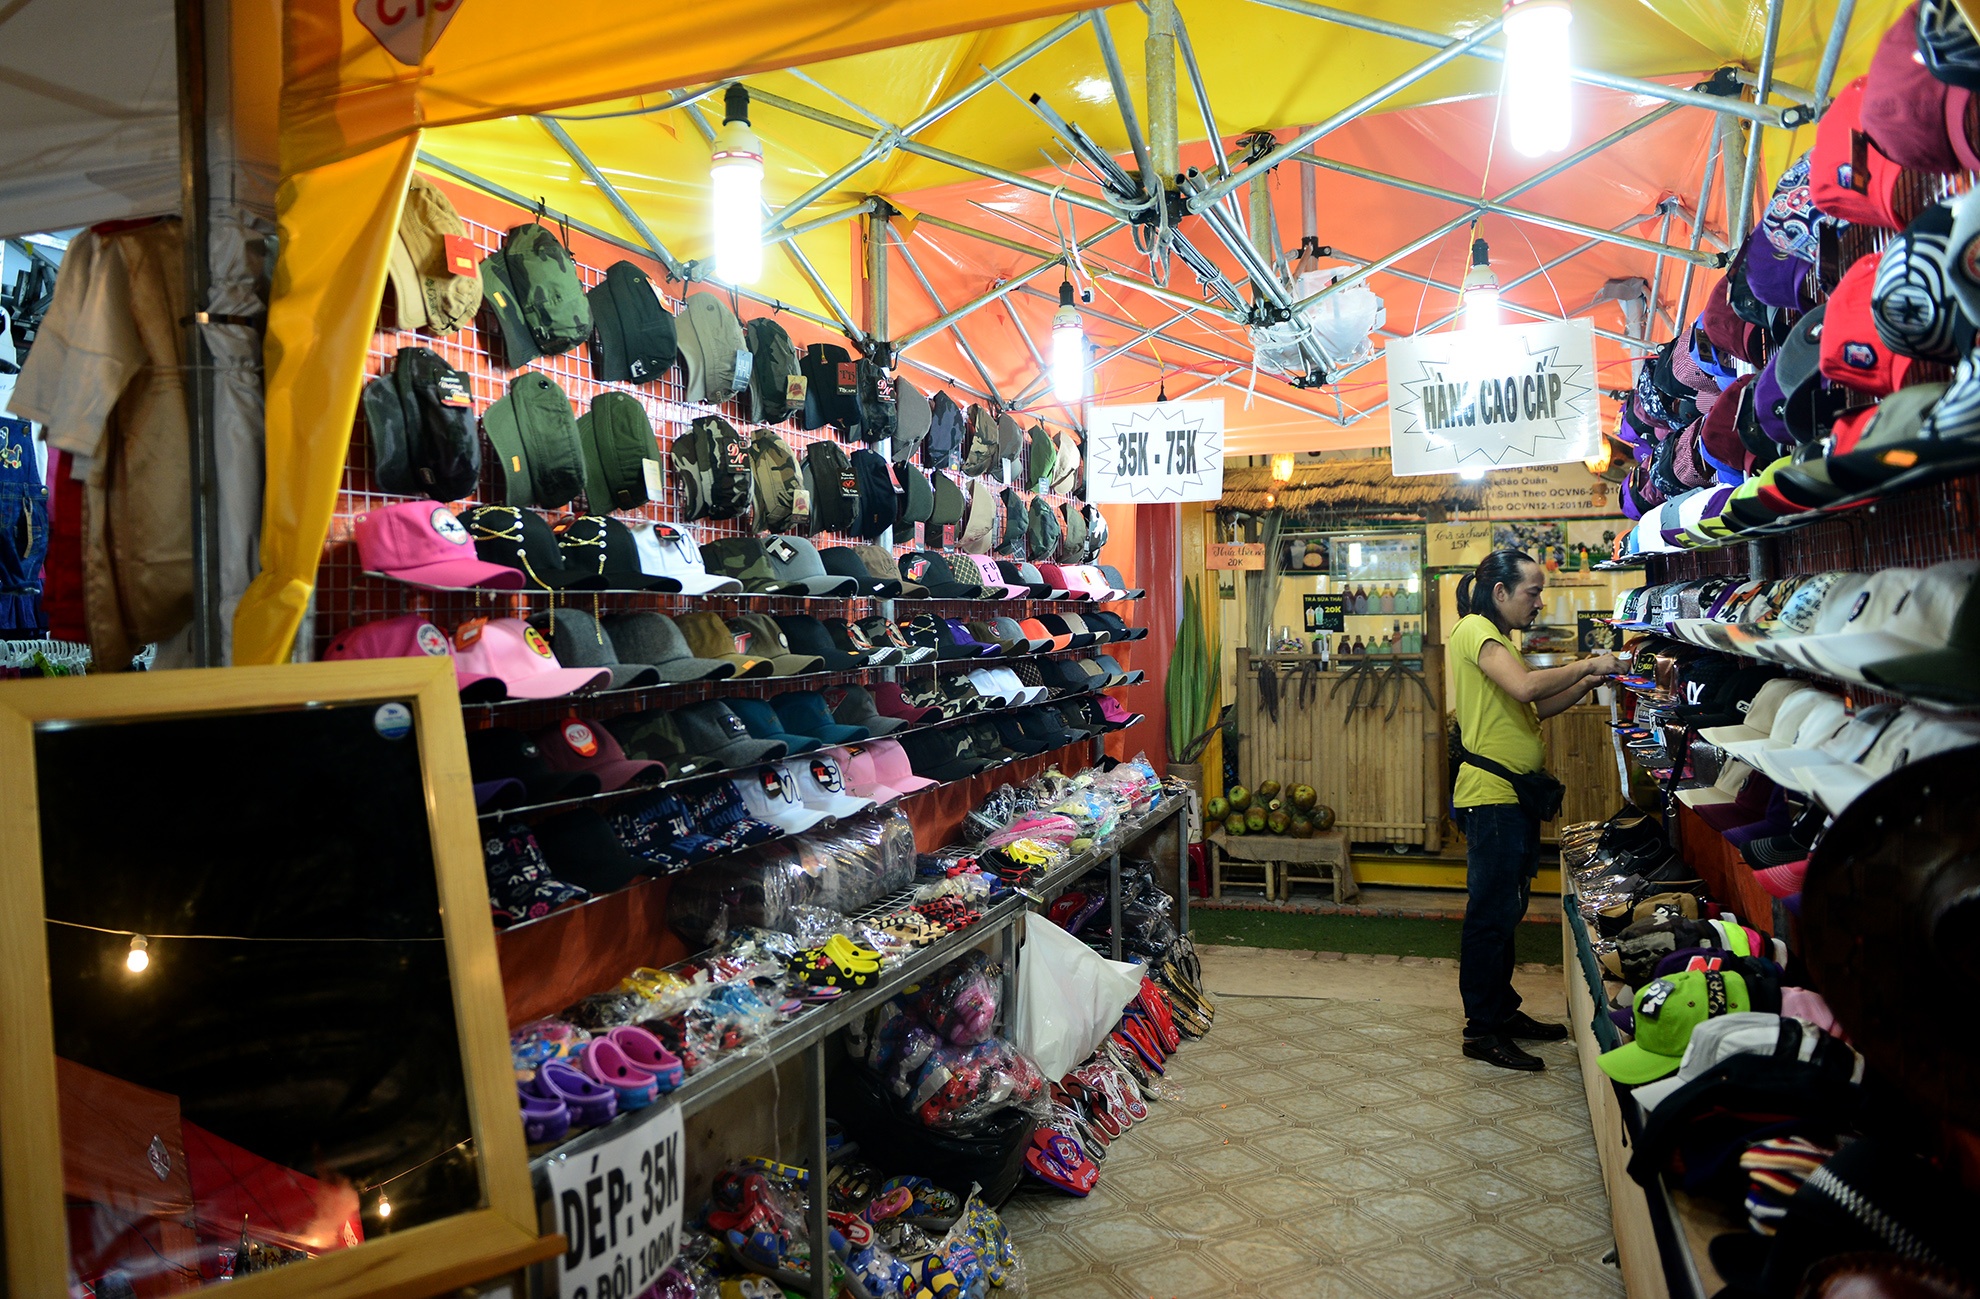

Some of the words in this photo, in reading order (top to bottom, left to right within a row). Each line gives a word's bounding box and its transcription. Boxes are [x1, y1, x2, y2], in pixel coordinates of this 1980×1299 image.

[1423, 370, 1476, 430] HÀNG
[1480, 376, 1518, 425] CAO
[1524, 356, 1562, 421] CẤP
[1117, 432, 1149, 477] 35K
[1166, 430, 1197, 475] 75K
[1523, 489, 1546, 497] Theo
[1228, 558, 1243, 566] 20K
[1451, 540, 1470, 550] 15K
[561, 1154, 633, 1272] DÉP:
[640, 1131, 679, 1225] 35K
[640, 1221, 675, 1286] 100K
